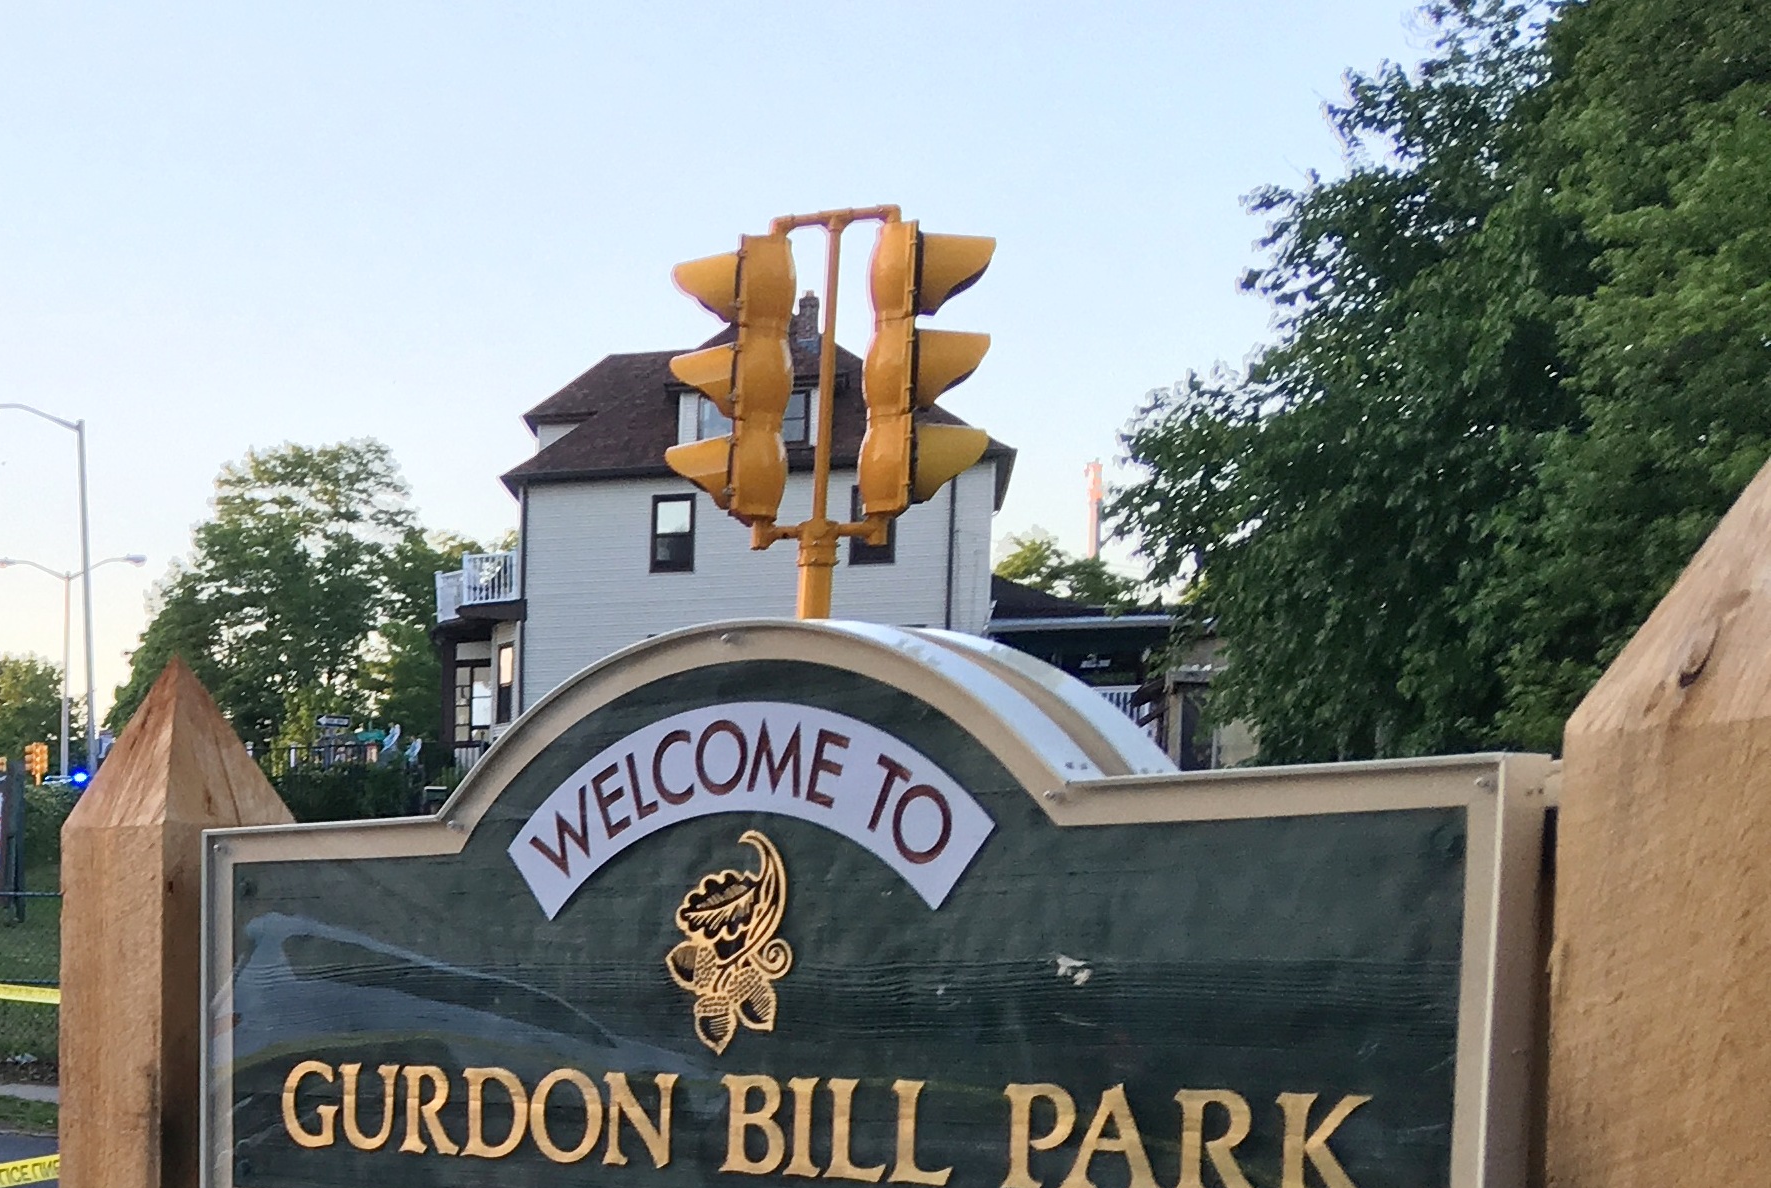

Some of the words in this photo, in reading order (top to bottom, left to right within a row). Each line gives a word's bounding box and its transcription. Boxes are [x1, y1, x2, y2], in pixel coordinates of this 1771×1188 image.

[530, 717, 851, 878] WELCOME
[866, 752, 953, 864] TO
[281, 1059, 680, 1169] GURDON
[718, 1073, 953, 1187] BILL
